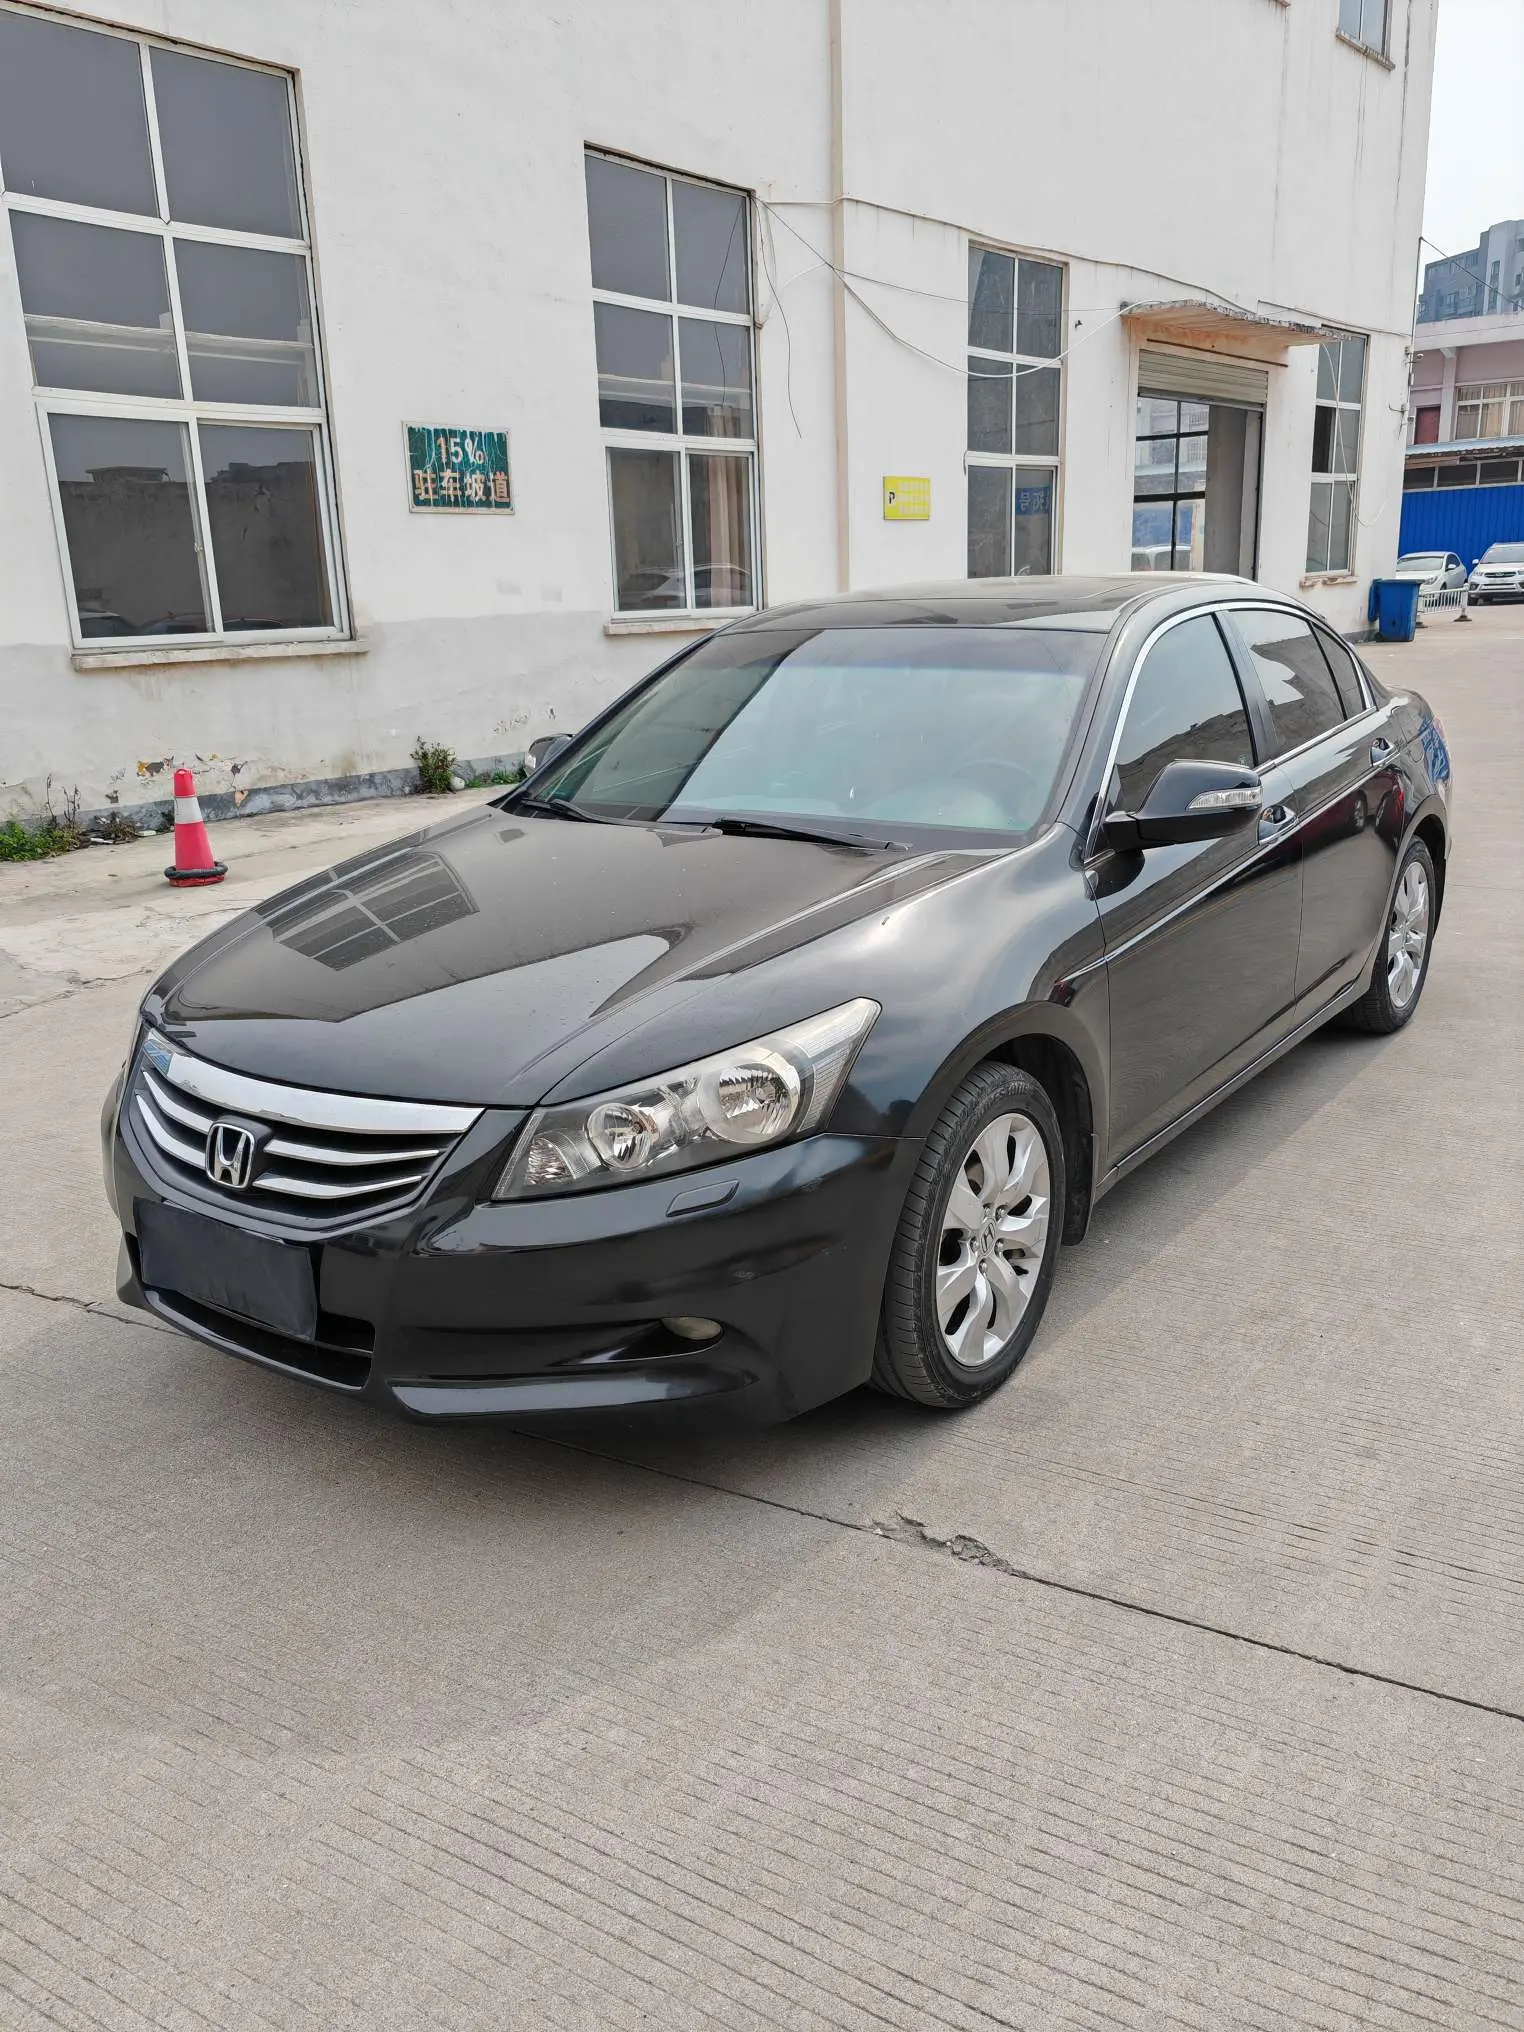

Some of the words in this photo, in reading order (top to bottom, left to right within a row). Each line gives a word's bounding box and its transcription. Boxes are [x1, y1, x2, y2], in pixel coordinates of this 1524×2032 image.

[437, 435, 484, 464] 15%
[413, 468, 510, 502] 驻车坡道
